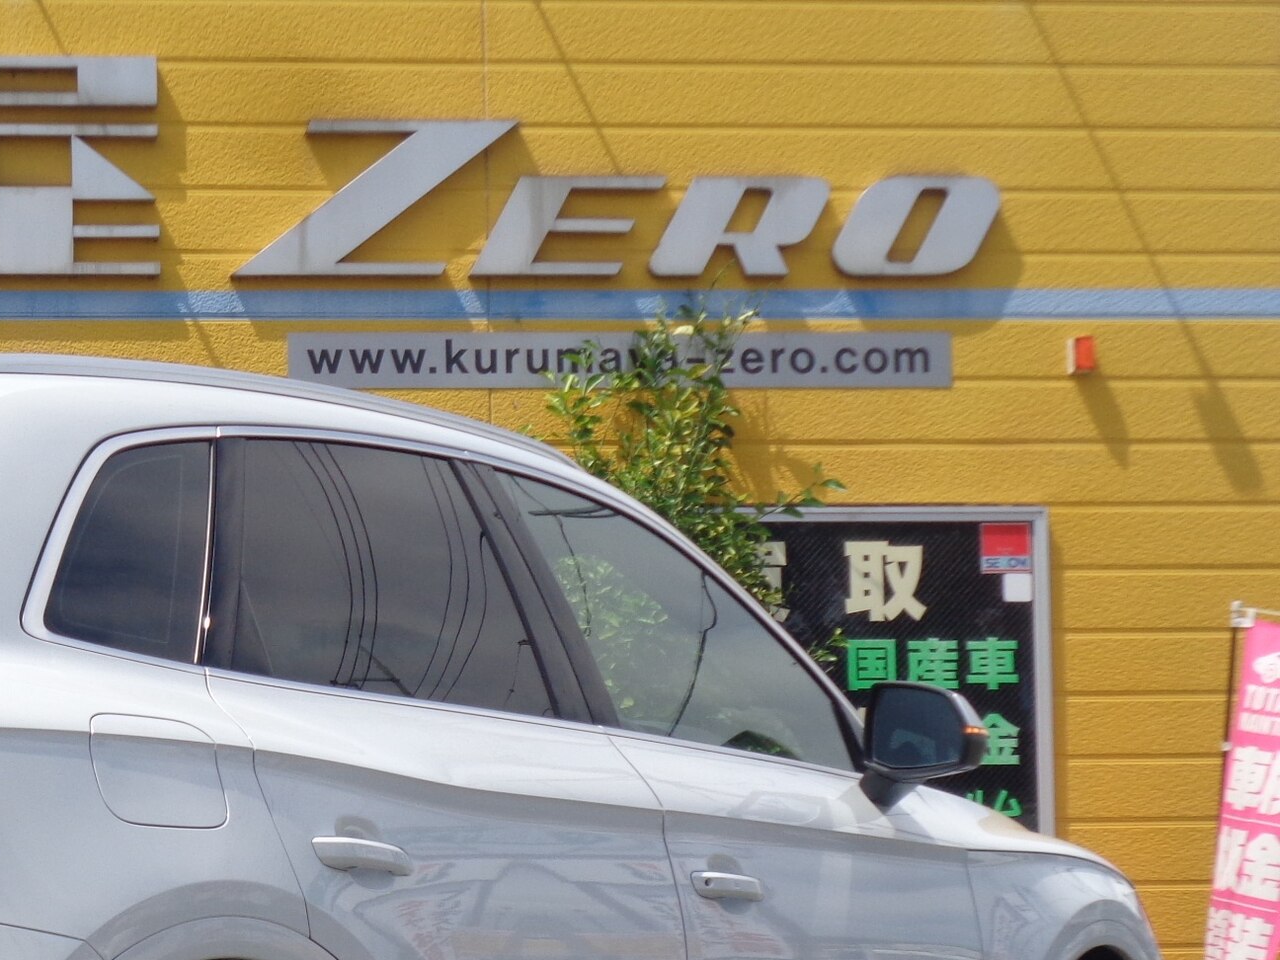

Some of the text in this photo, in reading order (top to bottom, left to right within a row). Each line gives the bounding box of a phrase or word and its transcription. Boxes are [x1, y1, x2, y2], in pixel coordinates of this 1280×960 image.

[230, 118, 1003, 279] ZERO
[847, 637, 1020, 692] 国産車
